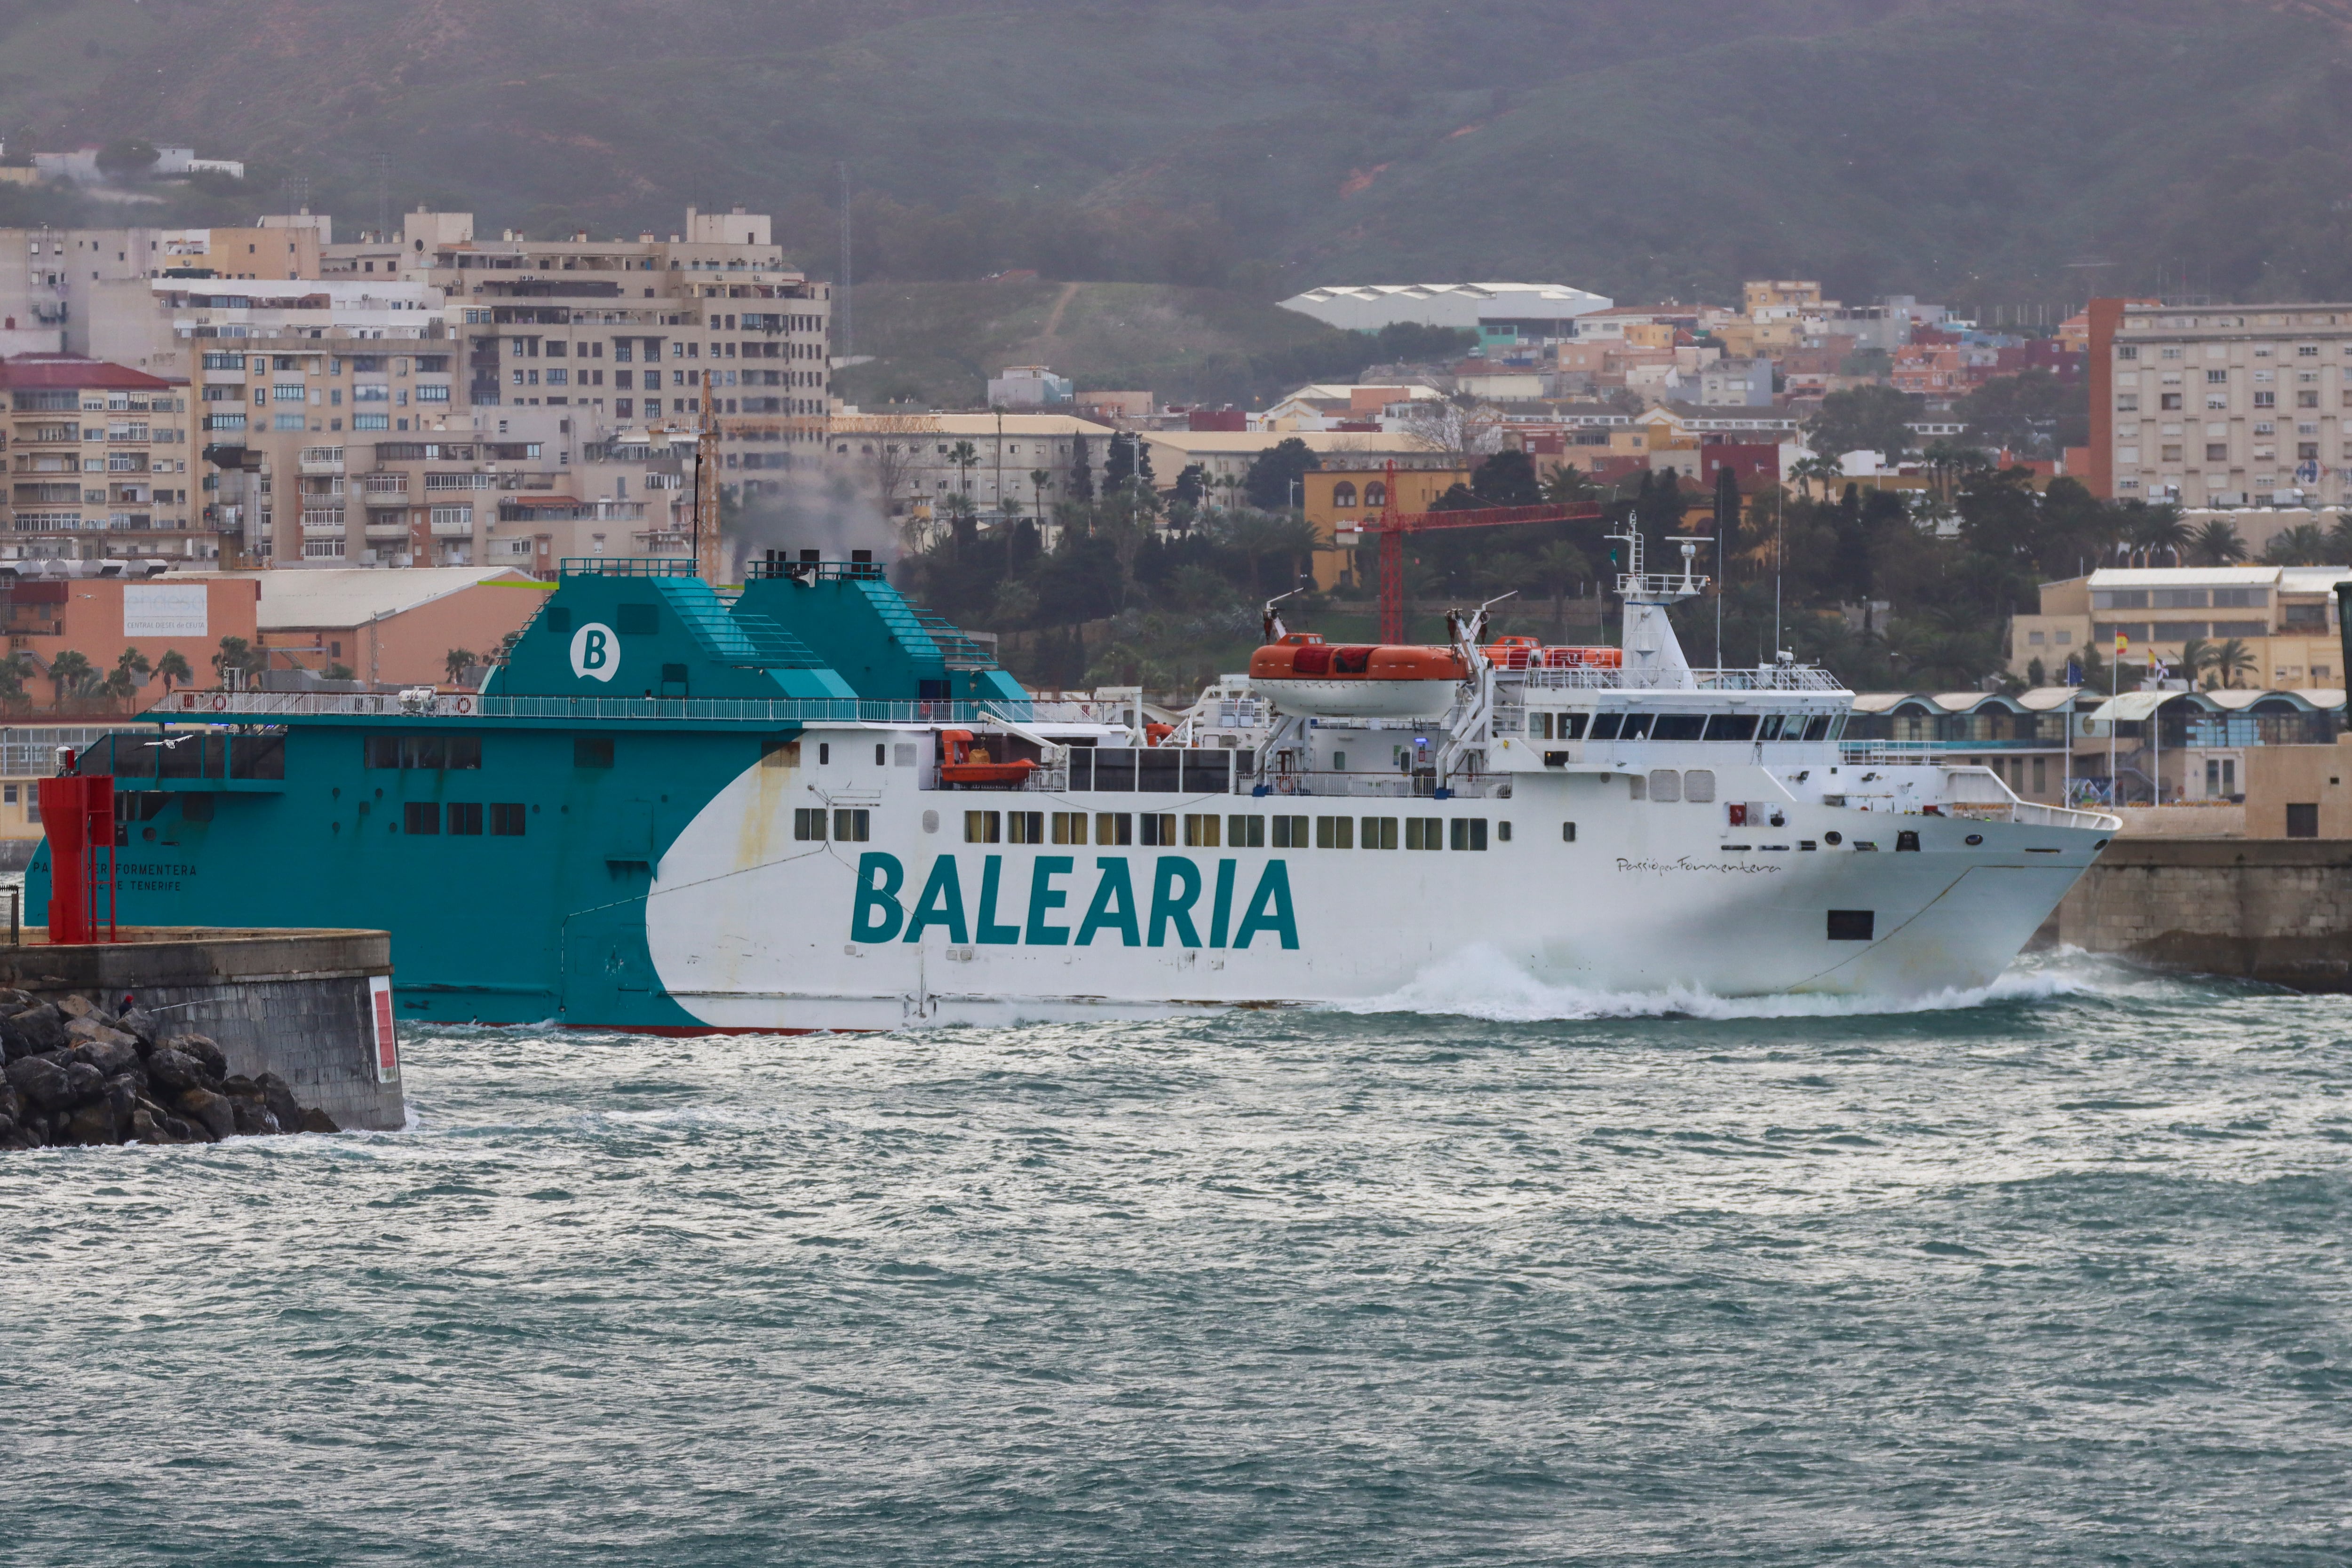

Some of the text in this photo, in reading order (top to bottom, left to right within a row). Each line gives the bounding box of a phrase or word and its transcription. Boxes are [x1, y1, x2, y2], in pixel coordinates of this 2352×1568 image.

[127, 591, 204, 610] endesa
[583, 630, 606, 669] B
[116, 863, 196, 876] FORMENTERA
[1677, 855, 1781, 874] Formentera
[130, 881, 181, 891] TENERIFE
